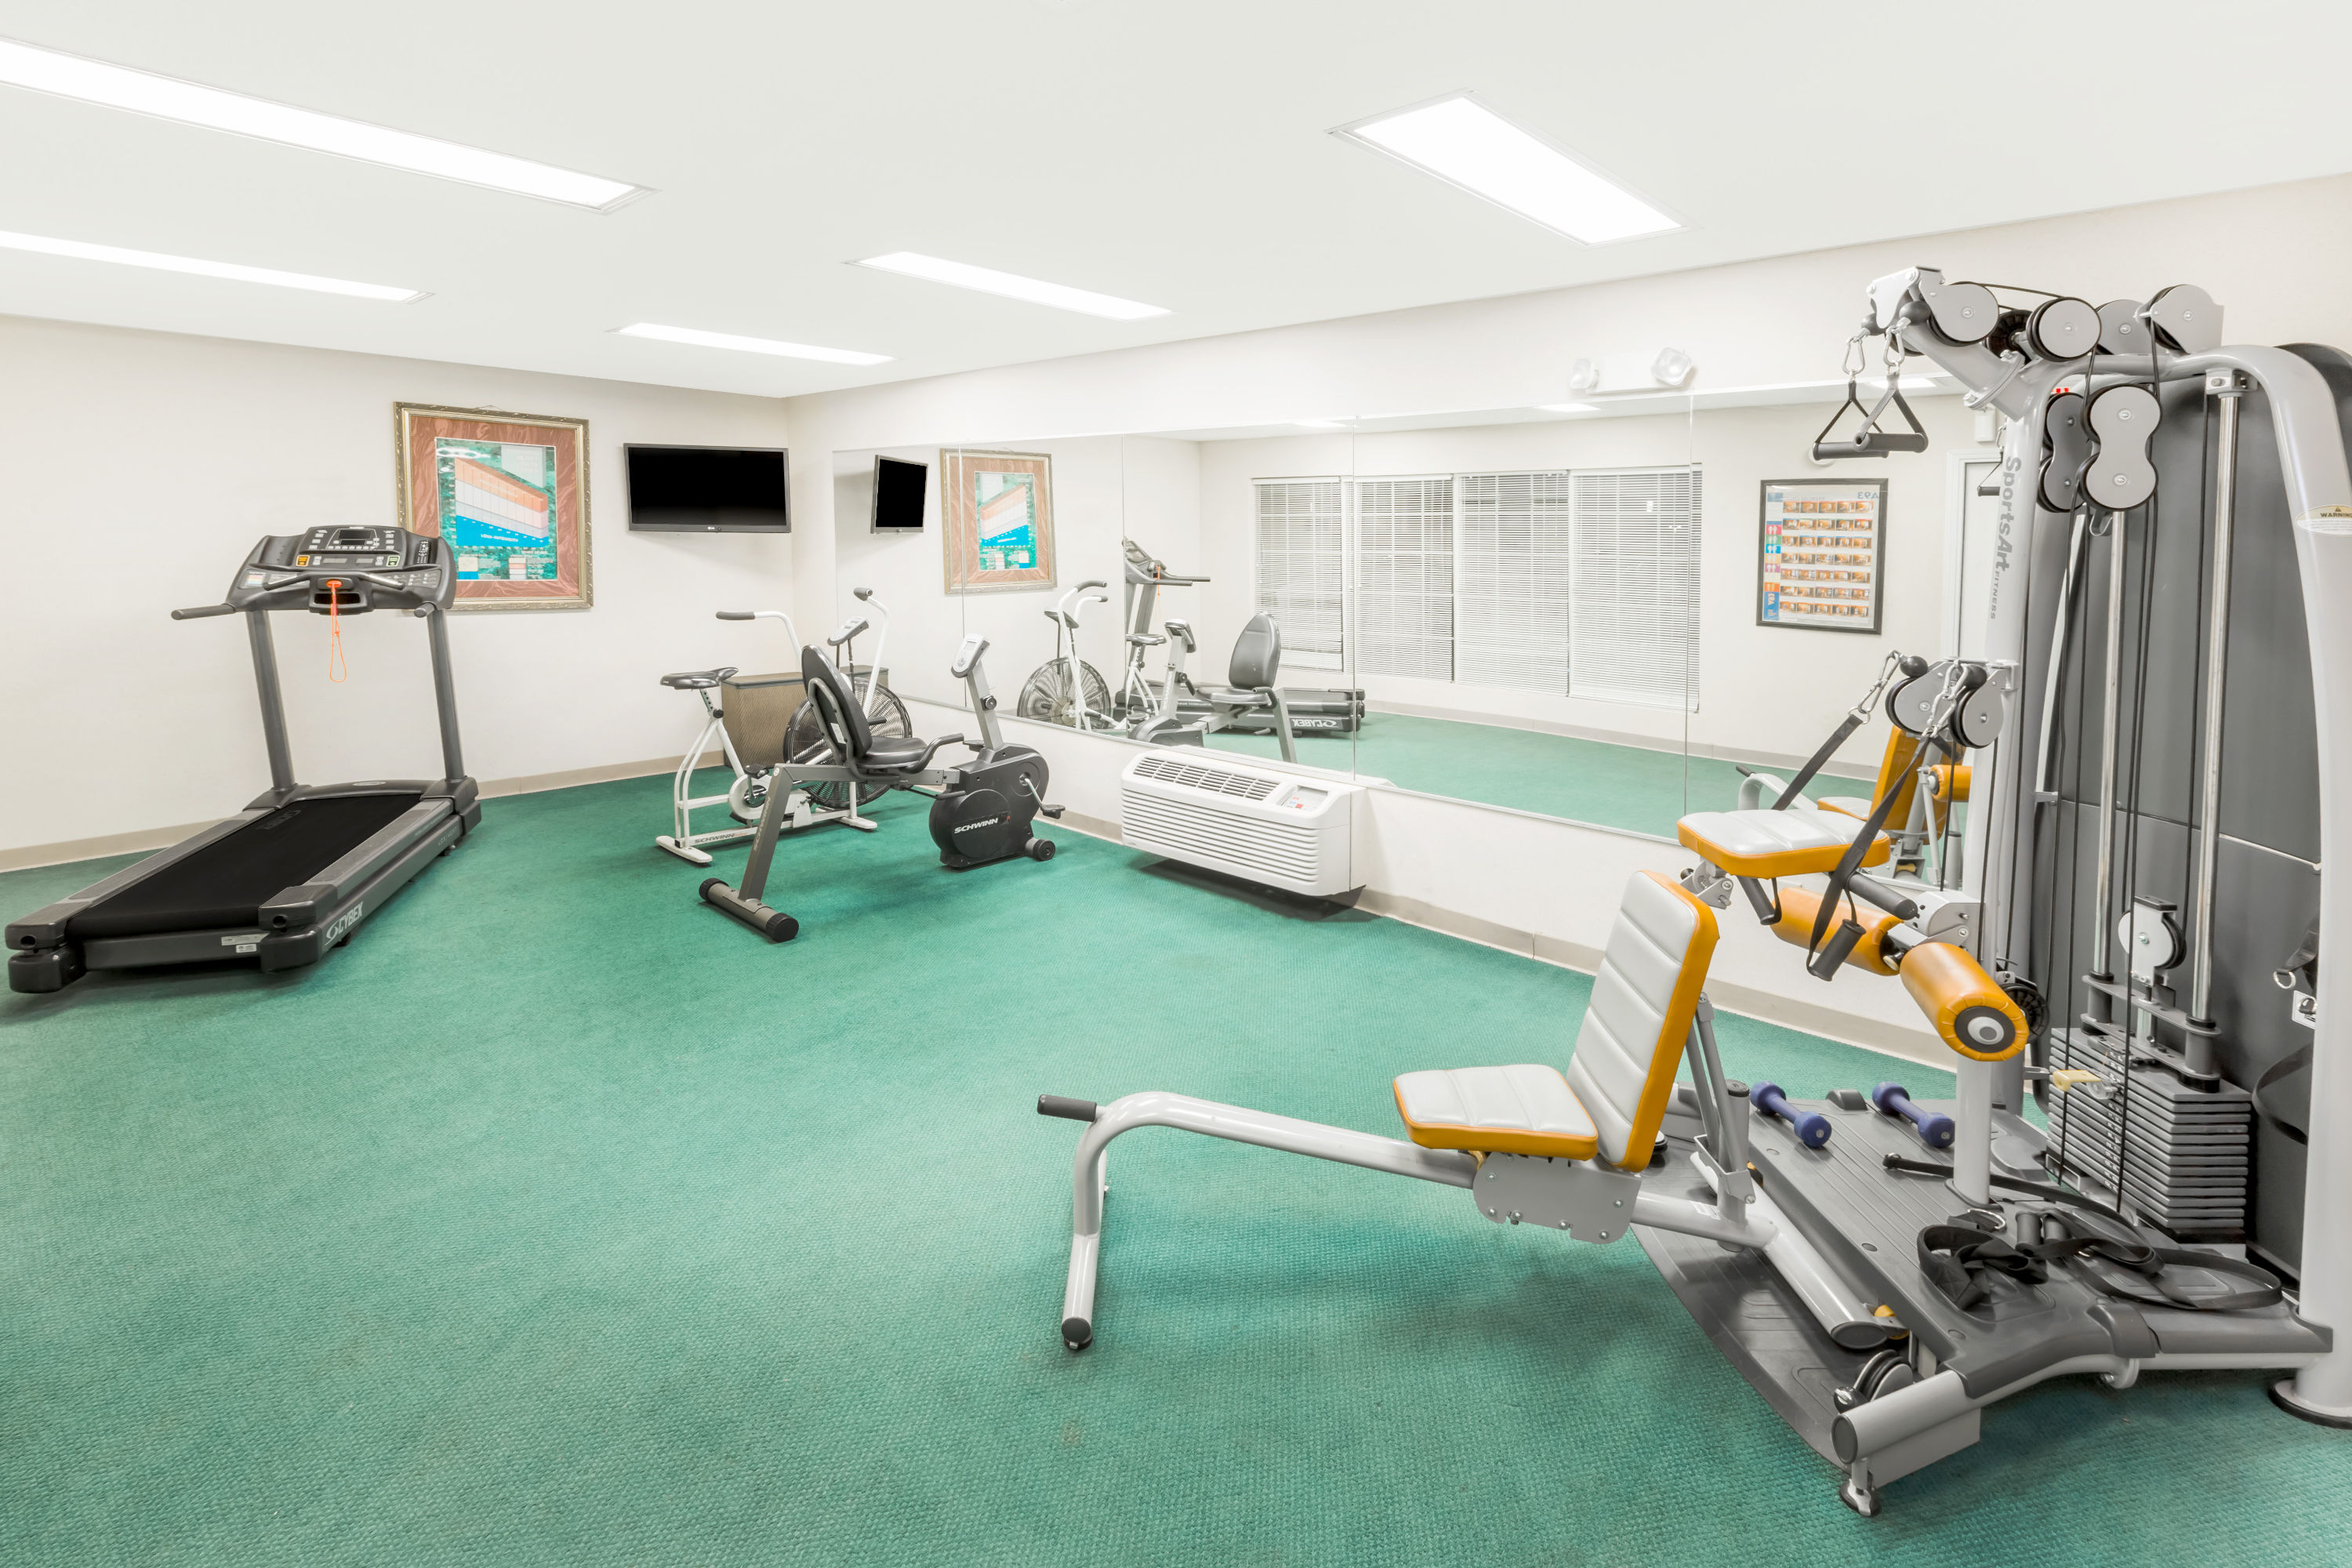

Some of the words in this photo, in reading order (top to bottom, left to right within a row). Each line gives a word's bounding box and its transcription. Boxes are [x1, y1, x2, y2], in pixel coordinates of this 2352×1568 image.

[1997, 456, 2022, 572] SportsArt
[1991, 571, 2000, 620] FITNESS
[695, 833, 735, 844] SCHWINN
[954, 818, 999, 834] SCHWINN
[338, 902, 364, 935] CYBEX
